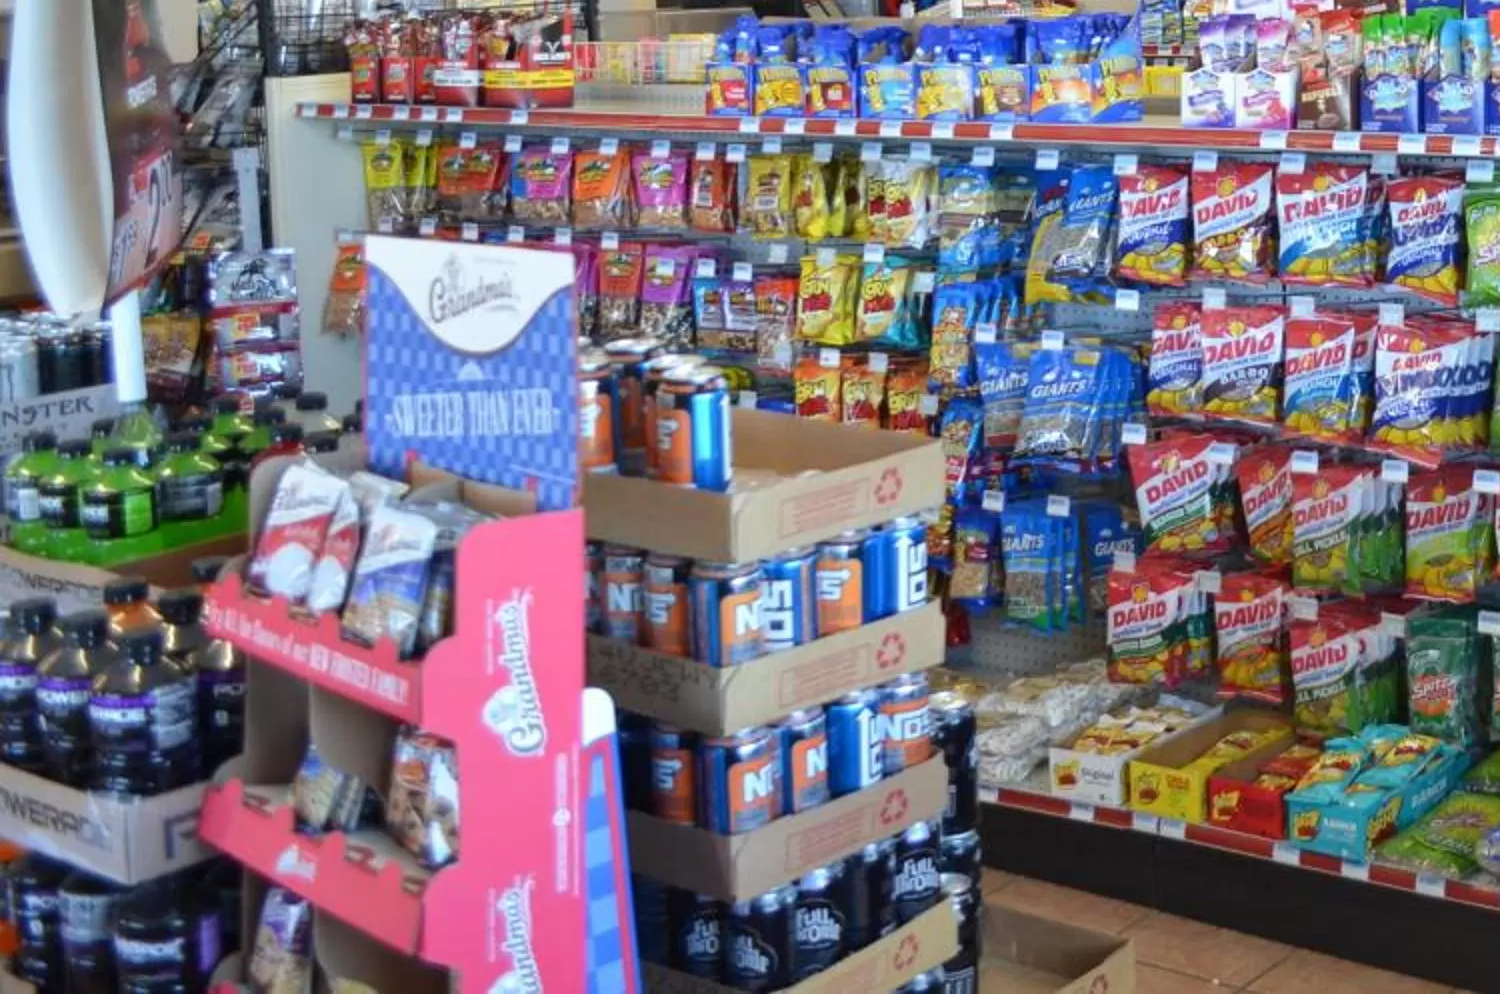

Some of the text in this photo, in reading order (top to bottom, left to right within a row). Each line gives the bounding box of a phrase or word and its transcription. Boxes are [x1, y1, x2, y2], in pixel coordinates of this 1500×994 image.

[1197, 190, 1257, 224] DAVID
[1032, 377, 1087, 399] GIANTS
[392, 387, 553, 439] SWEETER THAN EVER
[1146, 460, 1208, 504] DAVID
[1245, 471, 1287, 513] DAVID
[1295, 493, 1347, 524] DAVID
[1407, 499, 1469, 528] DAVID
[1095, 538, 1136, 556] GIANTS
[1113, 601, 1167, 628] DAVID
[1217, 596, 1278, 631] DAVID
[1292, 643, 1348, 674] DAVID
